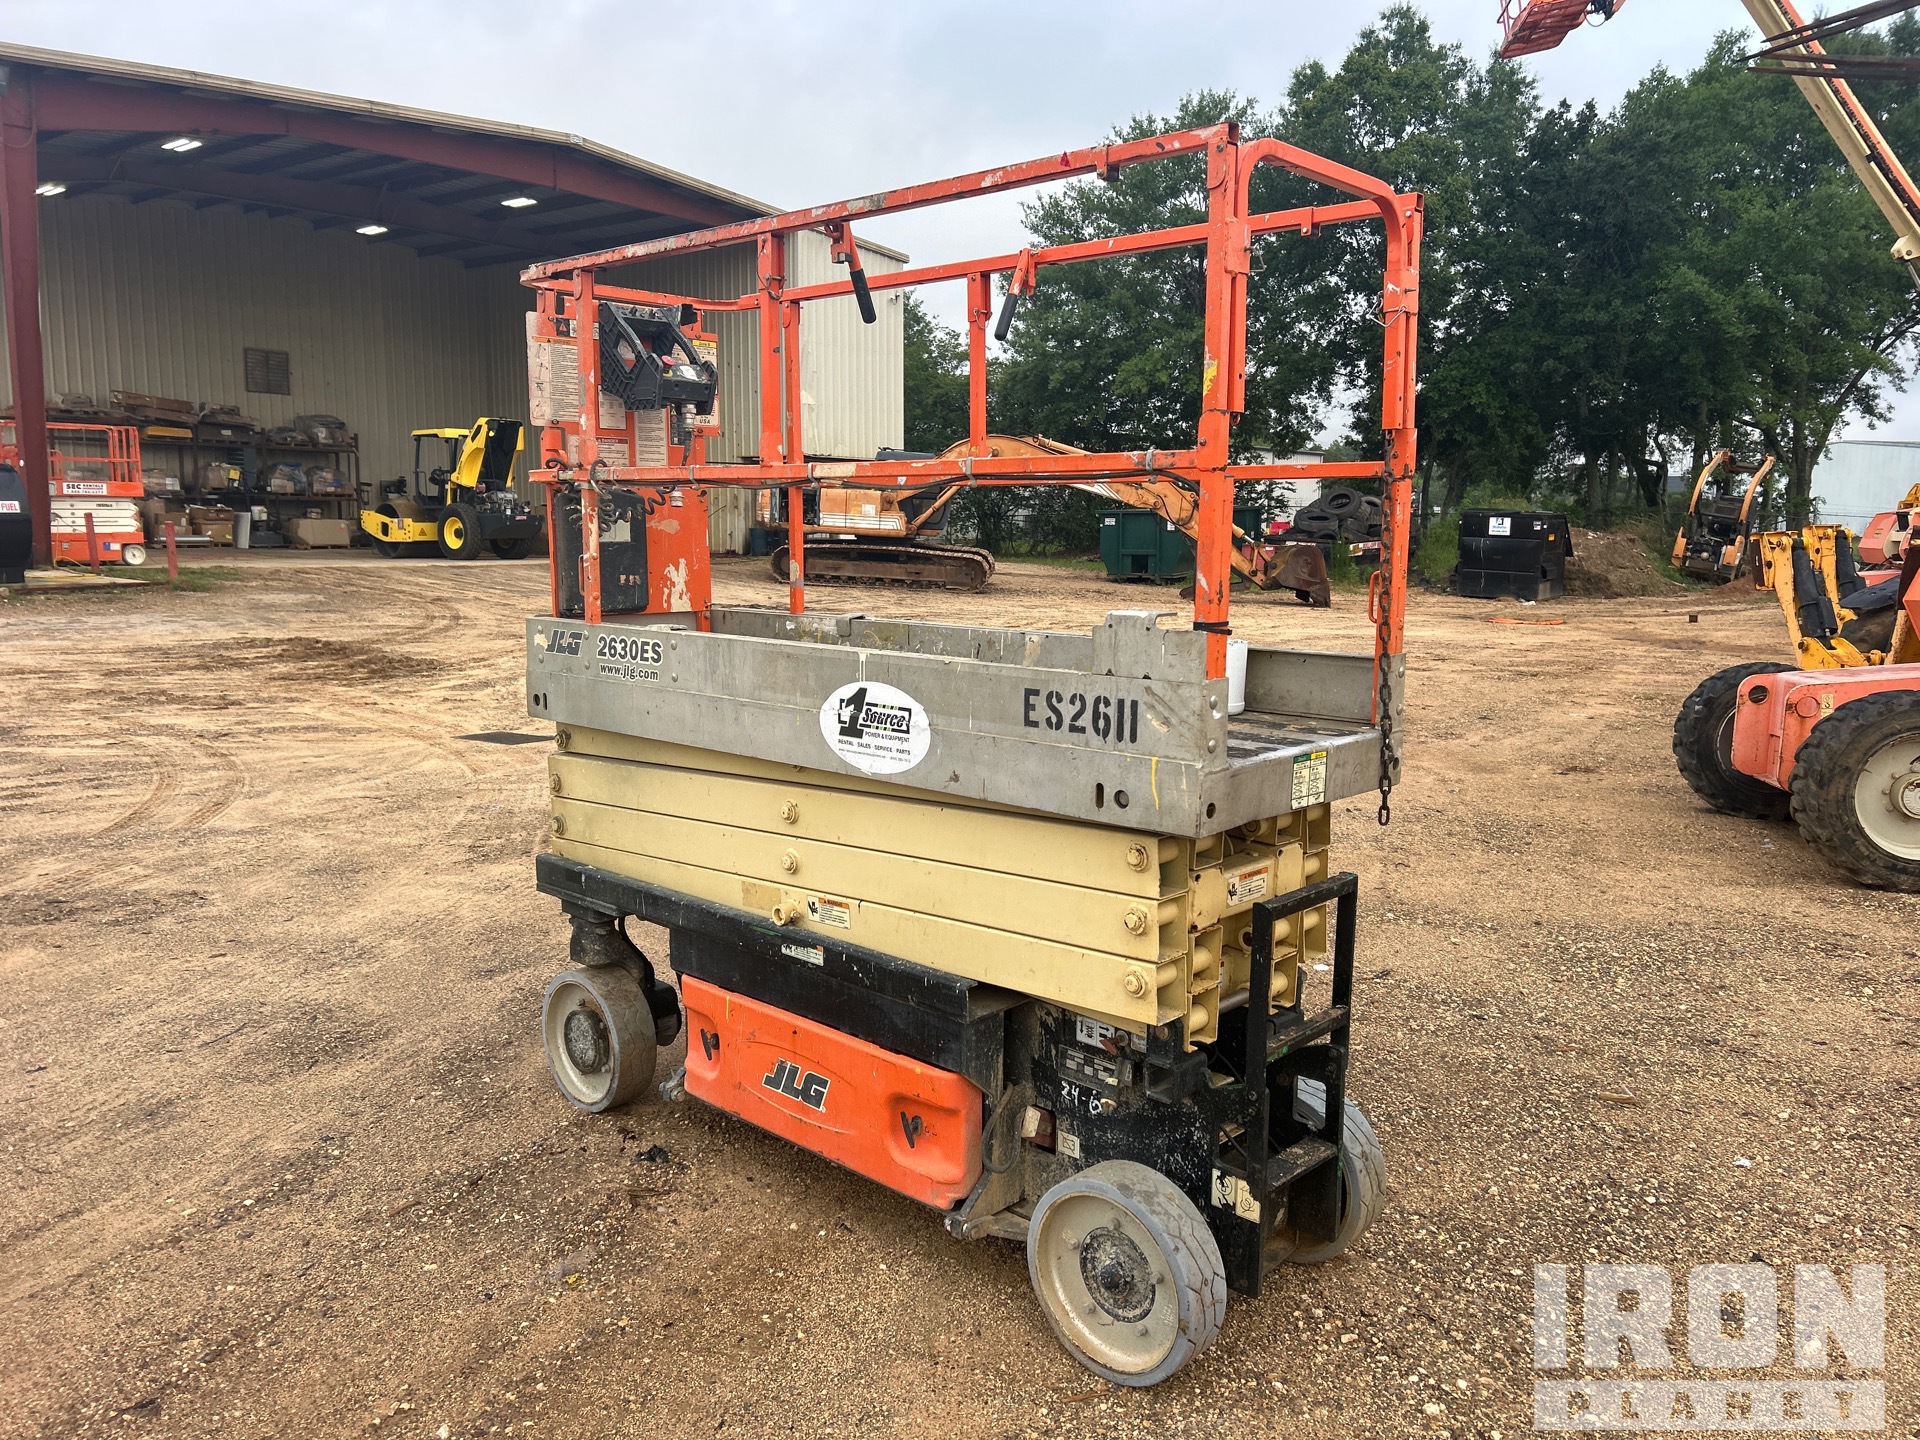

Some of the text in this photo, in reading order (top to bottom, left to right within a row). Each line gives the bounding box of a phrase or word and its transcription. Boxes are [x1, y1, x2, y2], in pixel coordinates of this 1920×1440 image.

[1, 502, 19, 511] FUEL
[545, 629, 583, 656] JLG
[597, 635, 662, 664] 2630ES
[600, 664, 659, 680] www.jlg.com
[862, 707, 906, 728] Source
[1023, 687, 1139, 744] ES2611
[857, 741, 872, 749] SALES
[874, 744, 893, 752] SERVICE
[864, 730, 881, 739] POWER
[885, 733, 910, 743] EQUIPMENT
[761, 1057, 831, 1112] JLG
